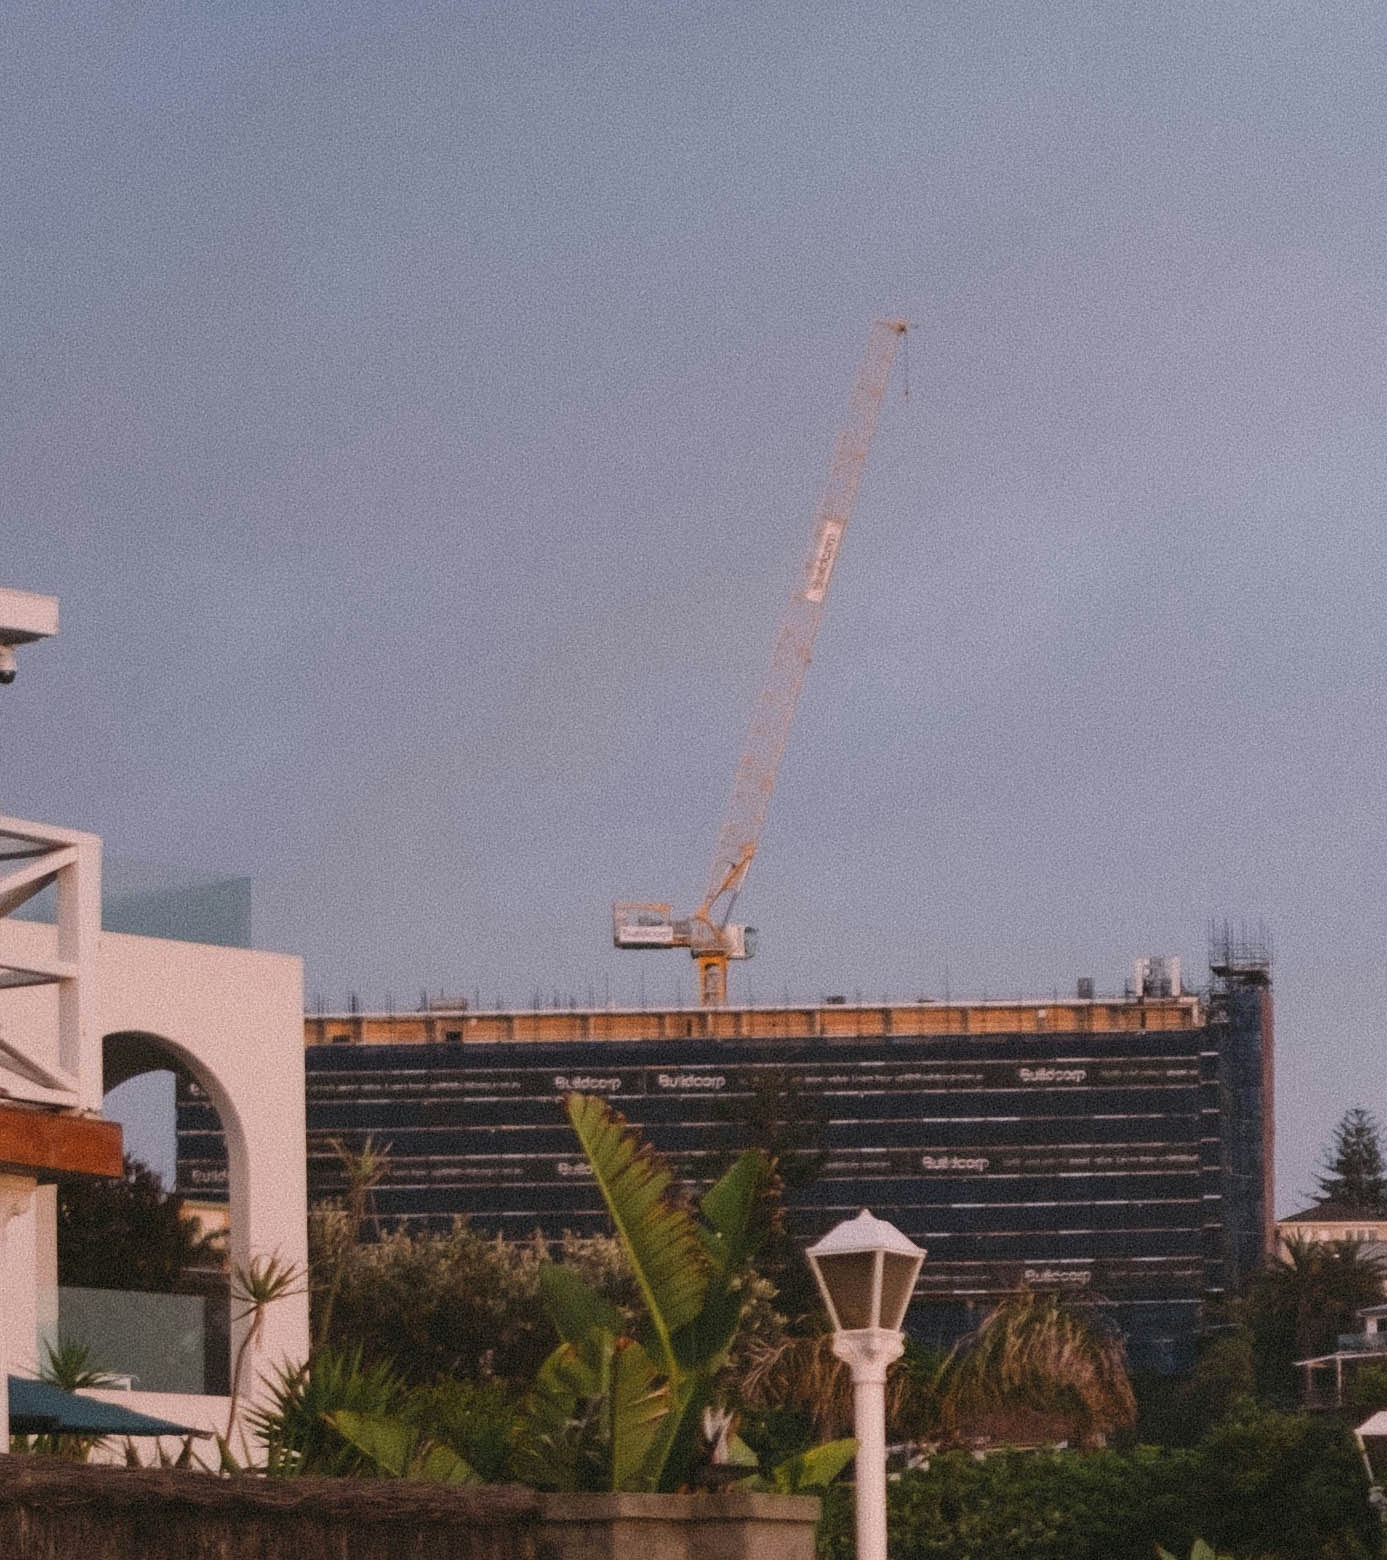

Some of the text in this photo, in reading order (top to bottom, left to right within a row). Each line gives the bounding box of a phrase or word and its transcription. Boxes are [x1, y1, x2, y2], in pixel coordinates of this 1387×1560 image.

[554, 1075, 622, 1091] Buildcorp
[658, 1074, 726, 1090] Buildcorp
[1018, 1068, 1088, 1084] Buildcorp
[922, 1155, 990, 1172] Buildcorp
[1024, 1268, 1092, 1285] Buildcorp
